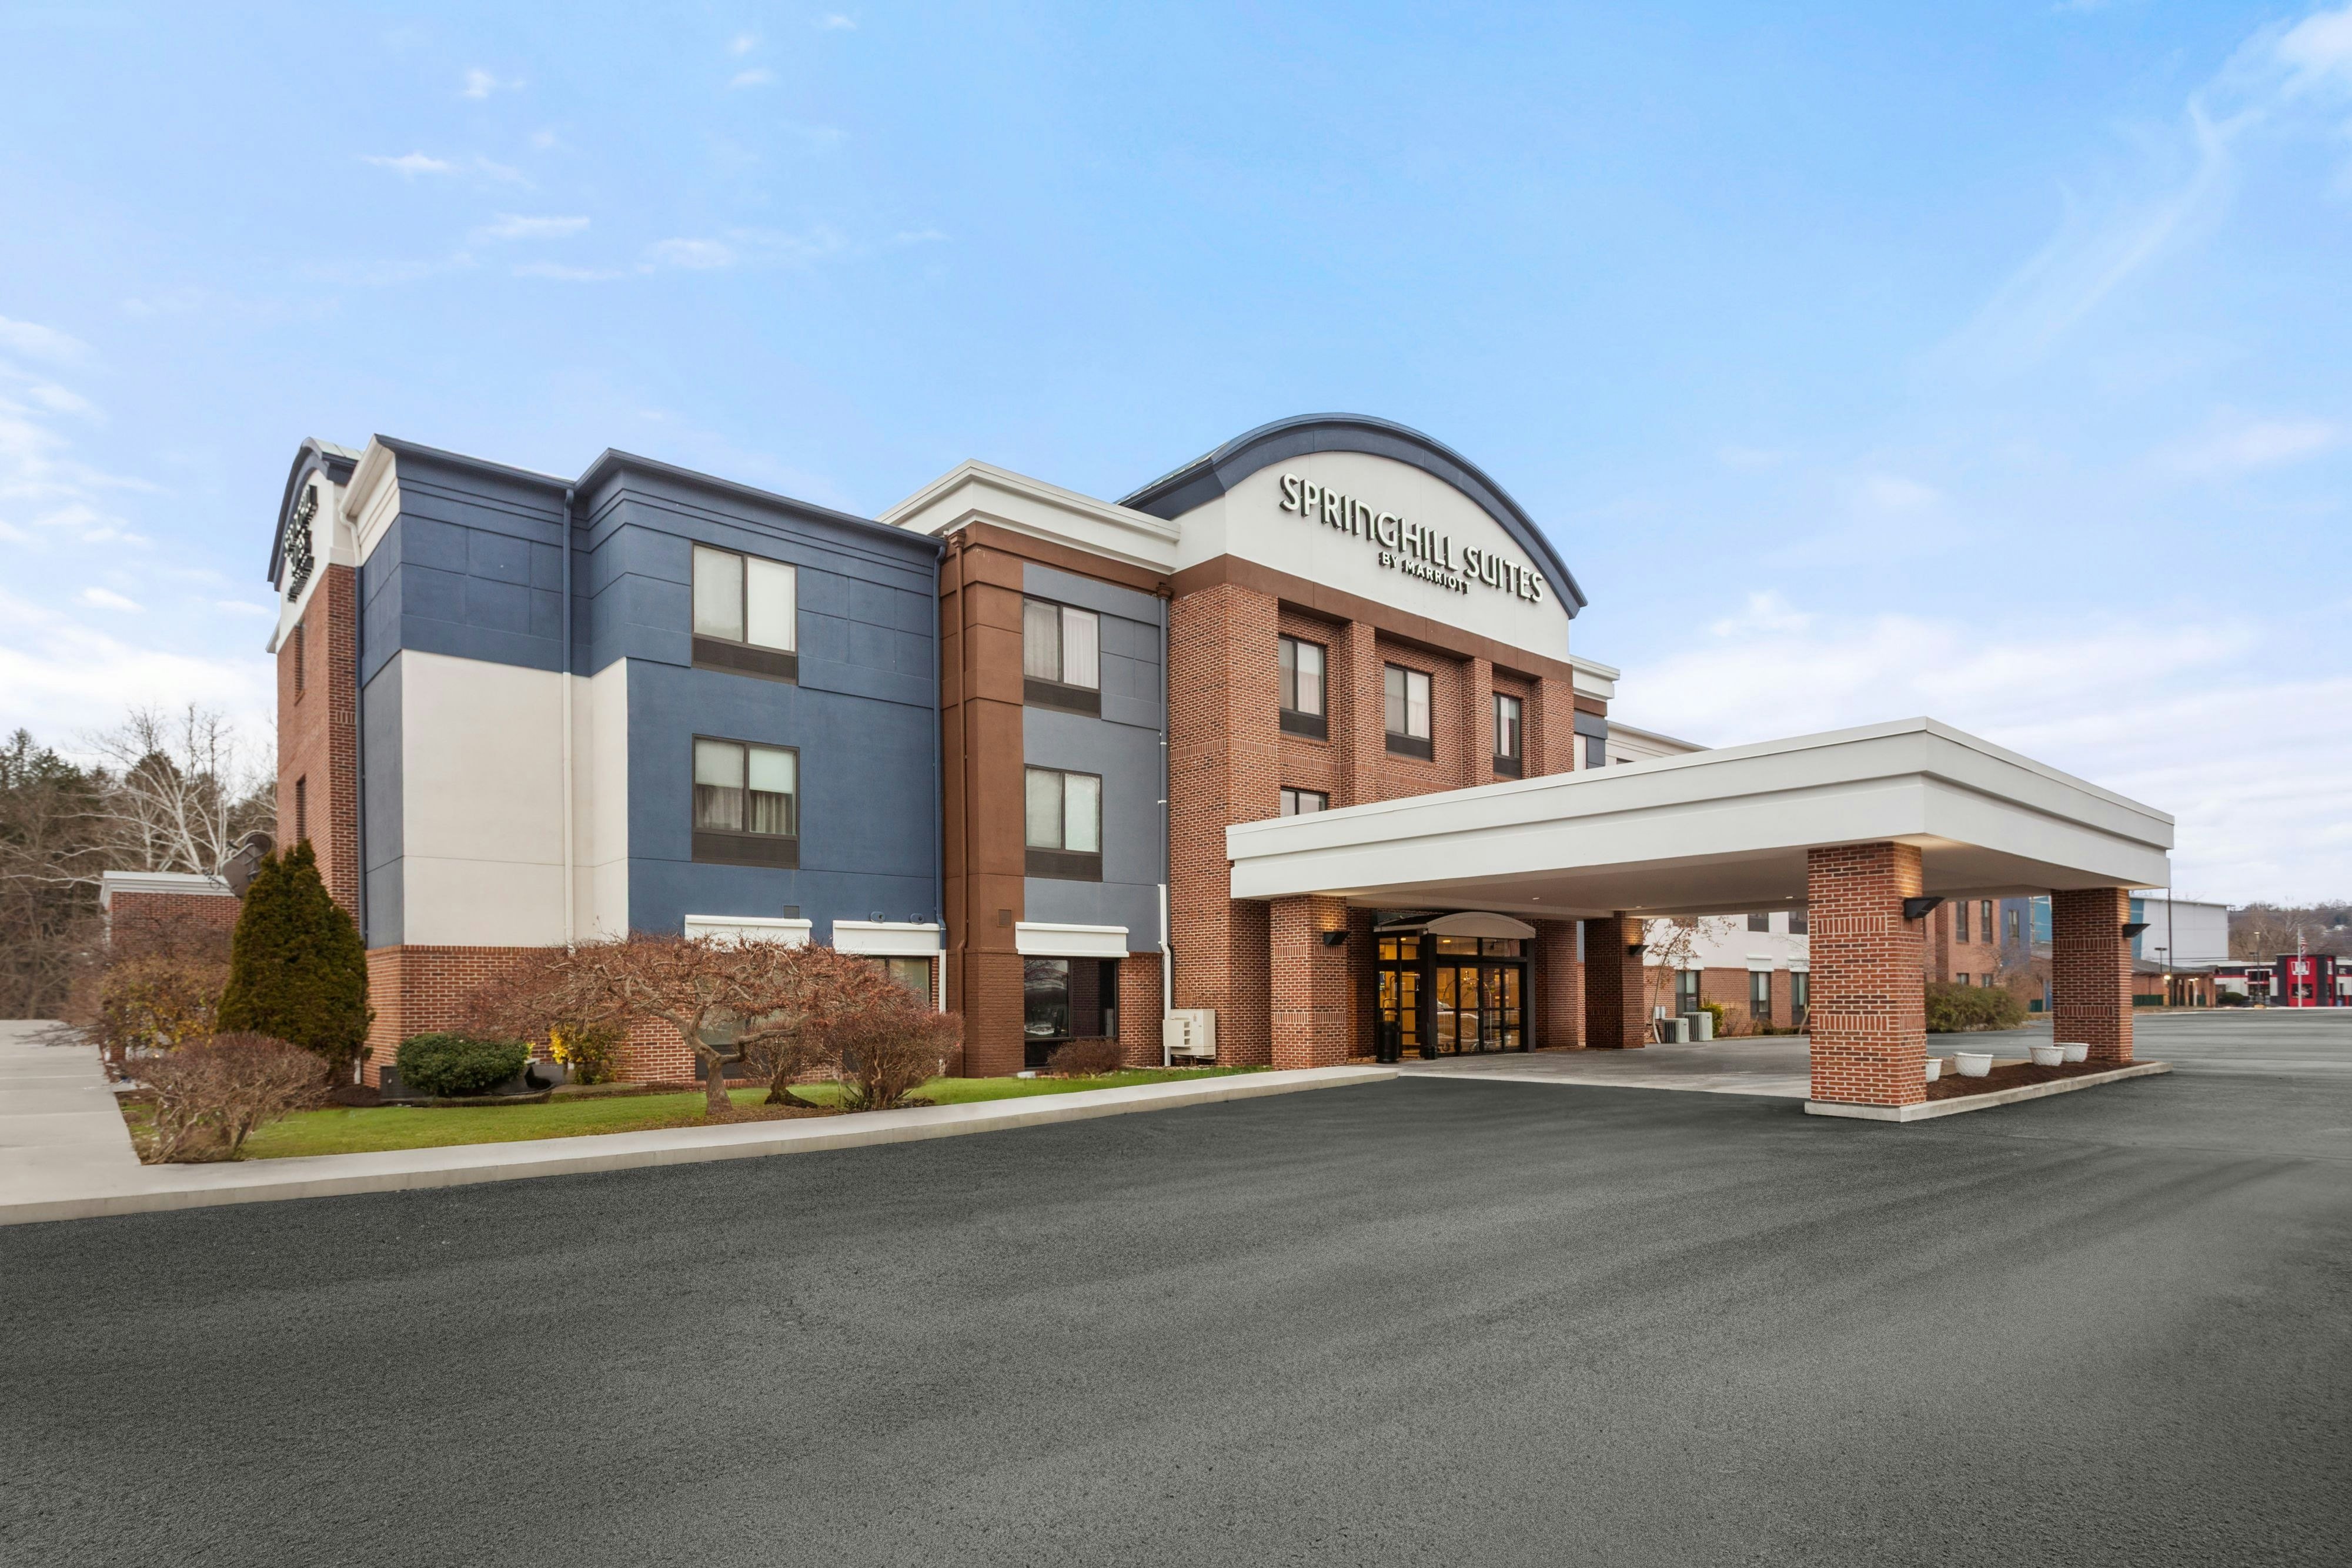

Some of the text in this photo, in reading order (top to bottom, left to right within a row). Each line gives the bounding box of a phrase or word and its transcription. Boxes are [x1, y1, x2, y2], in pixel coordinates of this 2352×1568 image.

[1279, 473, 1544, 603] SPRINGHILL SUITES
[1379, 551, 1471, 595] BY MARRIOTT
